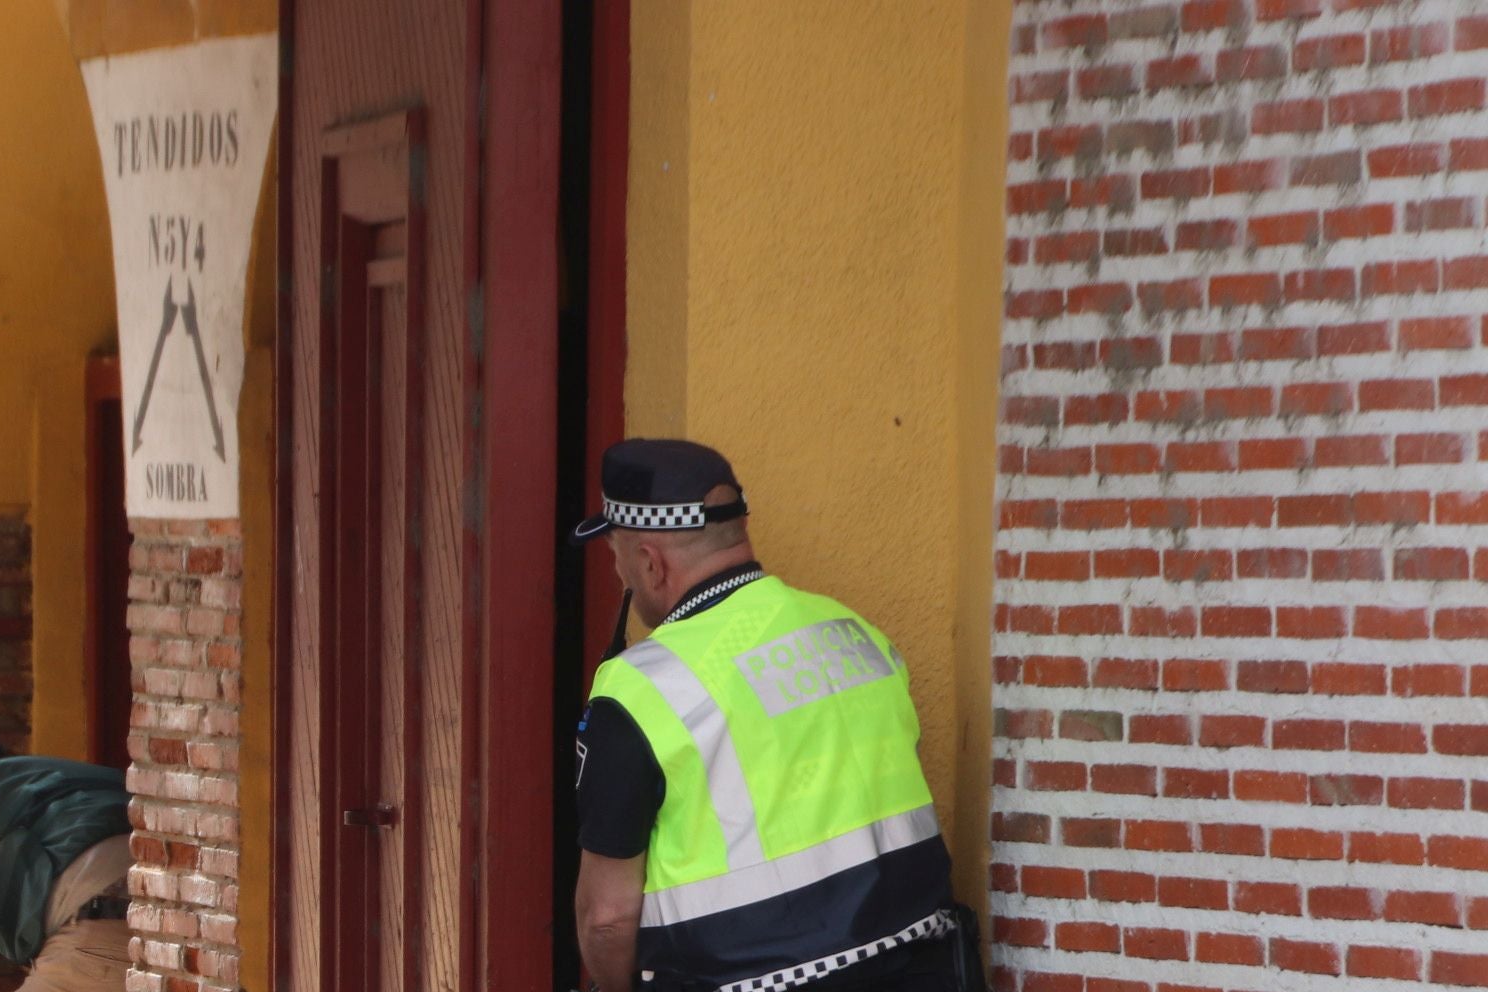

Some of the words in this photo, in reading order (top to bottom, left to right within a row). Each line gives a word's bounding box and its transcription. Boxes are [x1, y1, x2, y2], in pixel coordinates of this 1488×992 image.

[114, 109, 238, 178] TENDIDOS
[146, 463, 208, 502] SOMBRA
[747, 623, 866, 680] POLICIA
[776, 656, 875, 704] LOCAL
